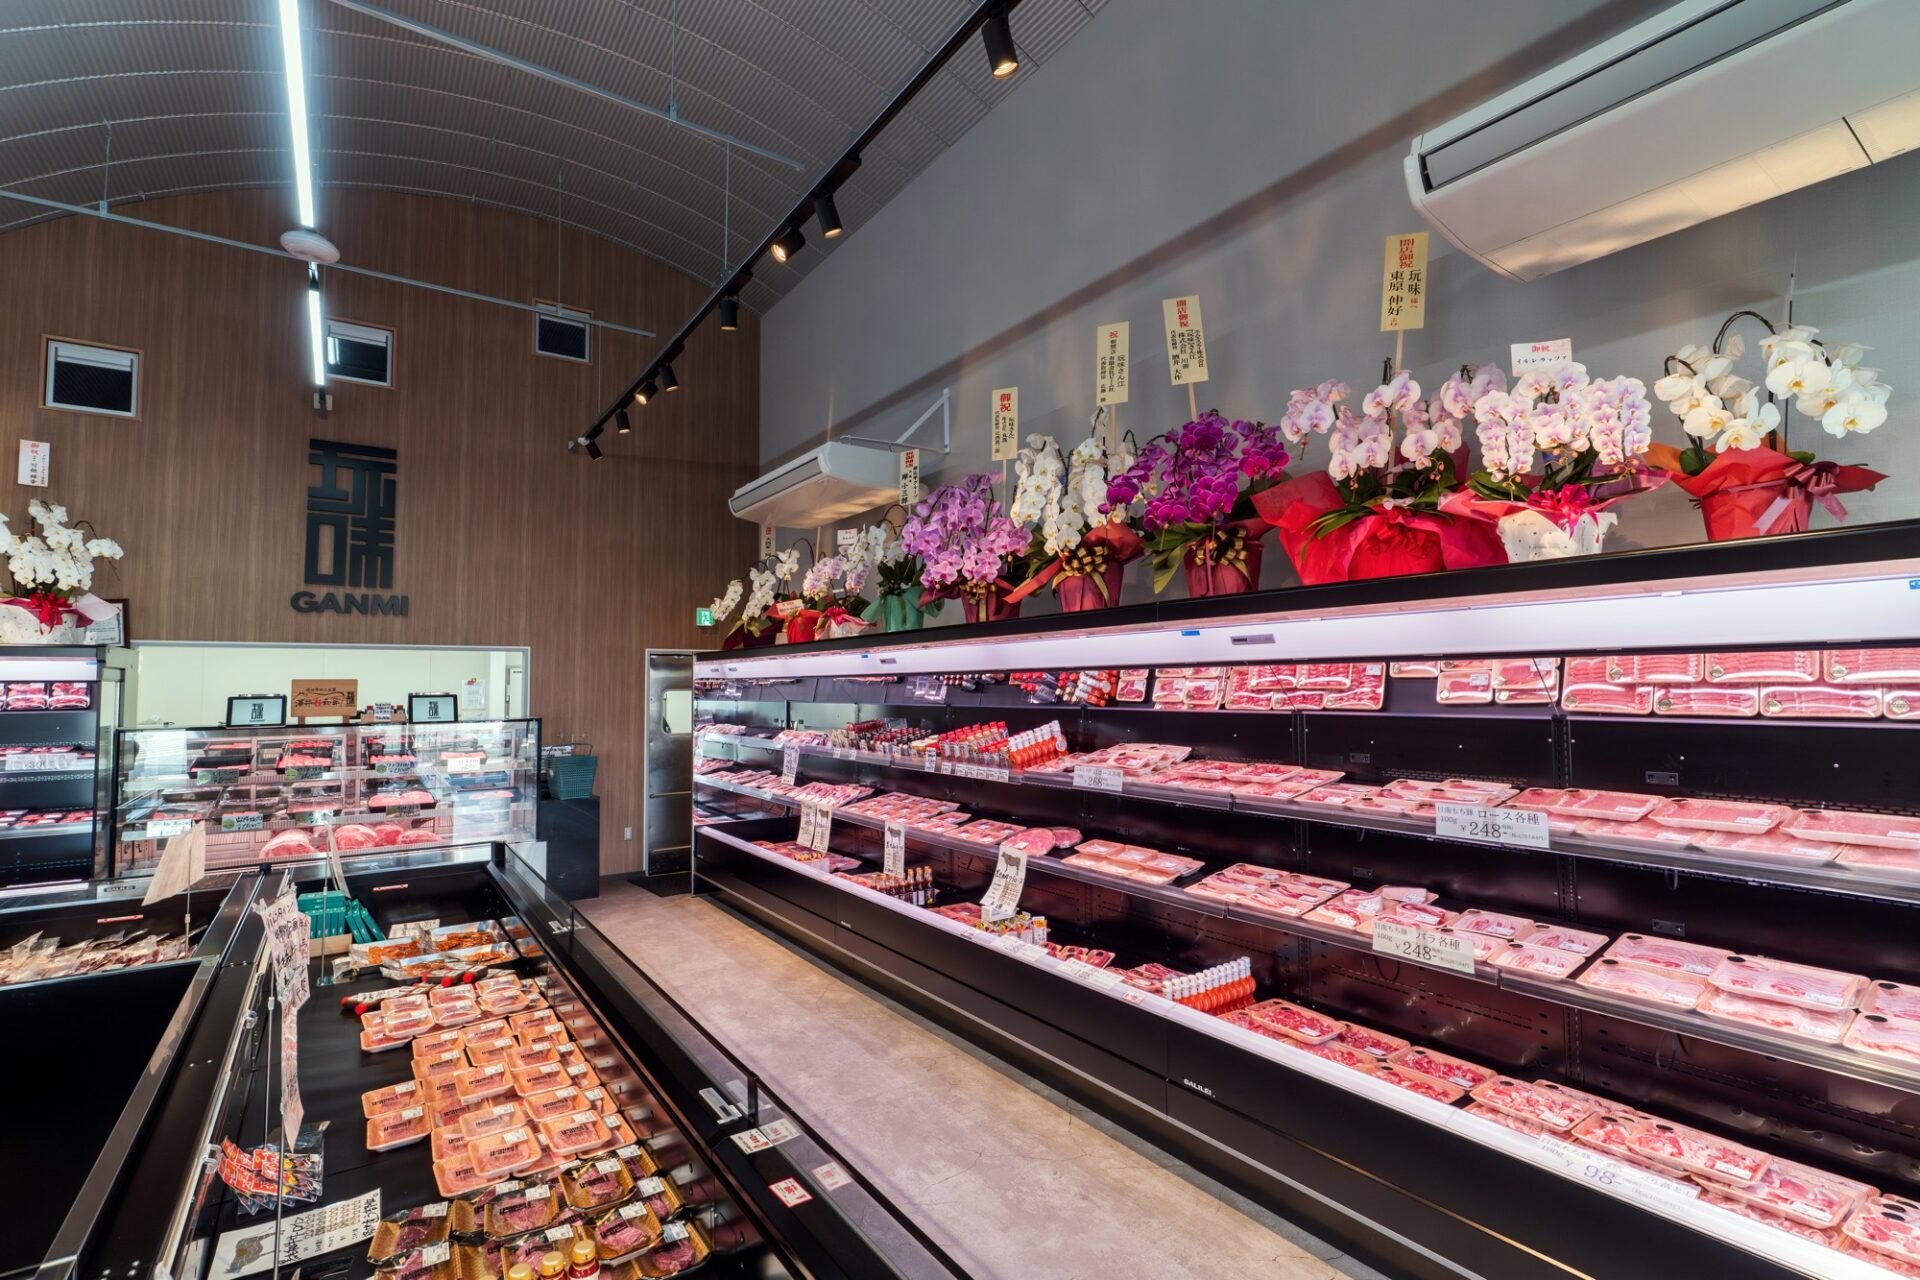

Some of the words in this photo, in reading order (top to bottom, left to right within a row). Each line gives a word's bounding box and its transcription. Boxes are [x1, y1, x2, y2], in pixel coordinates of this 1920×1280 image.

[290, 591, 409, 617] GANMI
[1478, 810, 1540, 825] ロース各種
[1416, 932, 1460, 951] バラ各種
